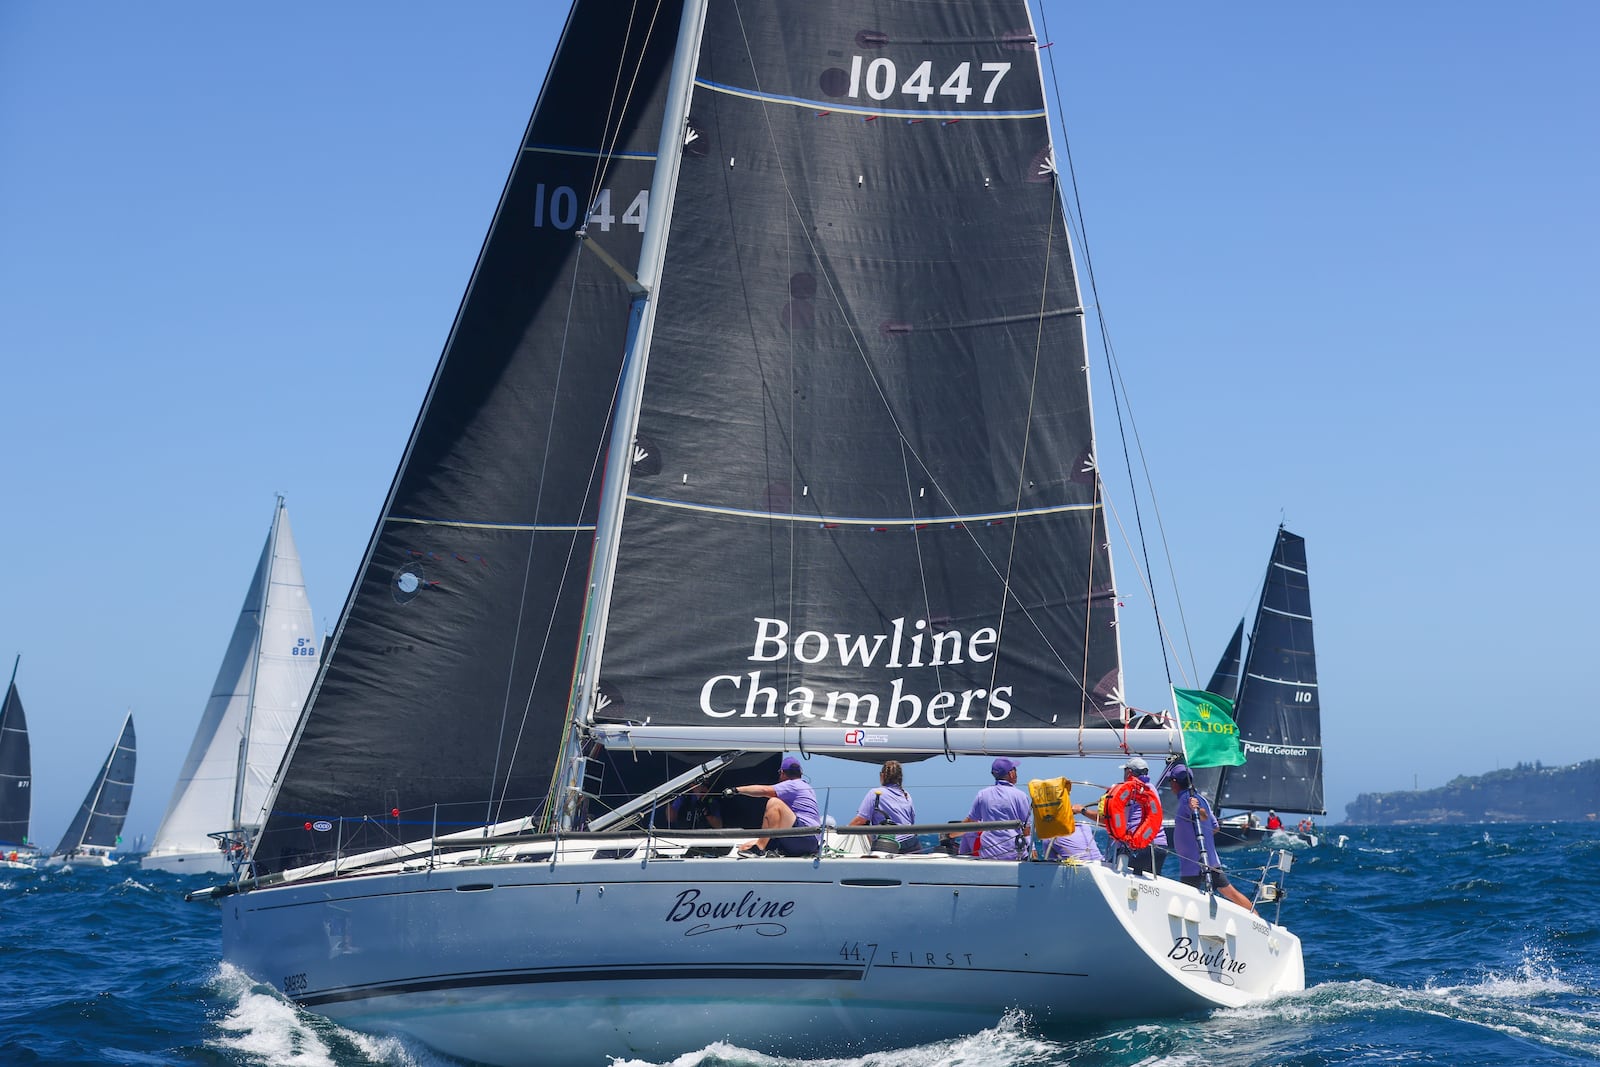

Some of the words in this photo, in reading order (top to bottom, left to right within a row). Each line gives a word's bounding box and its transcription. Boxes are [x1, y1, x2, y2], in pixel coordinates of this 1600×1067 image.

[847, 55, 1012, 105] 10447
[292, 647, 315, 656] 888
[746, 616, 999, 668] Bowline
[699, 670, 1013, 729] Chambers
[1295, 691, 1312, 703] 110
[1244, 743, 1274, 755] Pacific
[1274, 746, 1308, 756] Geotech
[1138, 883, 1160, 897] RSAYS
[666, 888, 795, 923] Bowline
[891, 951, 974, 966] FIRST
[1167, 936, 1248, 974] Bowline
